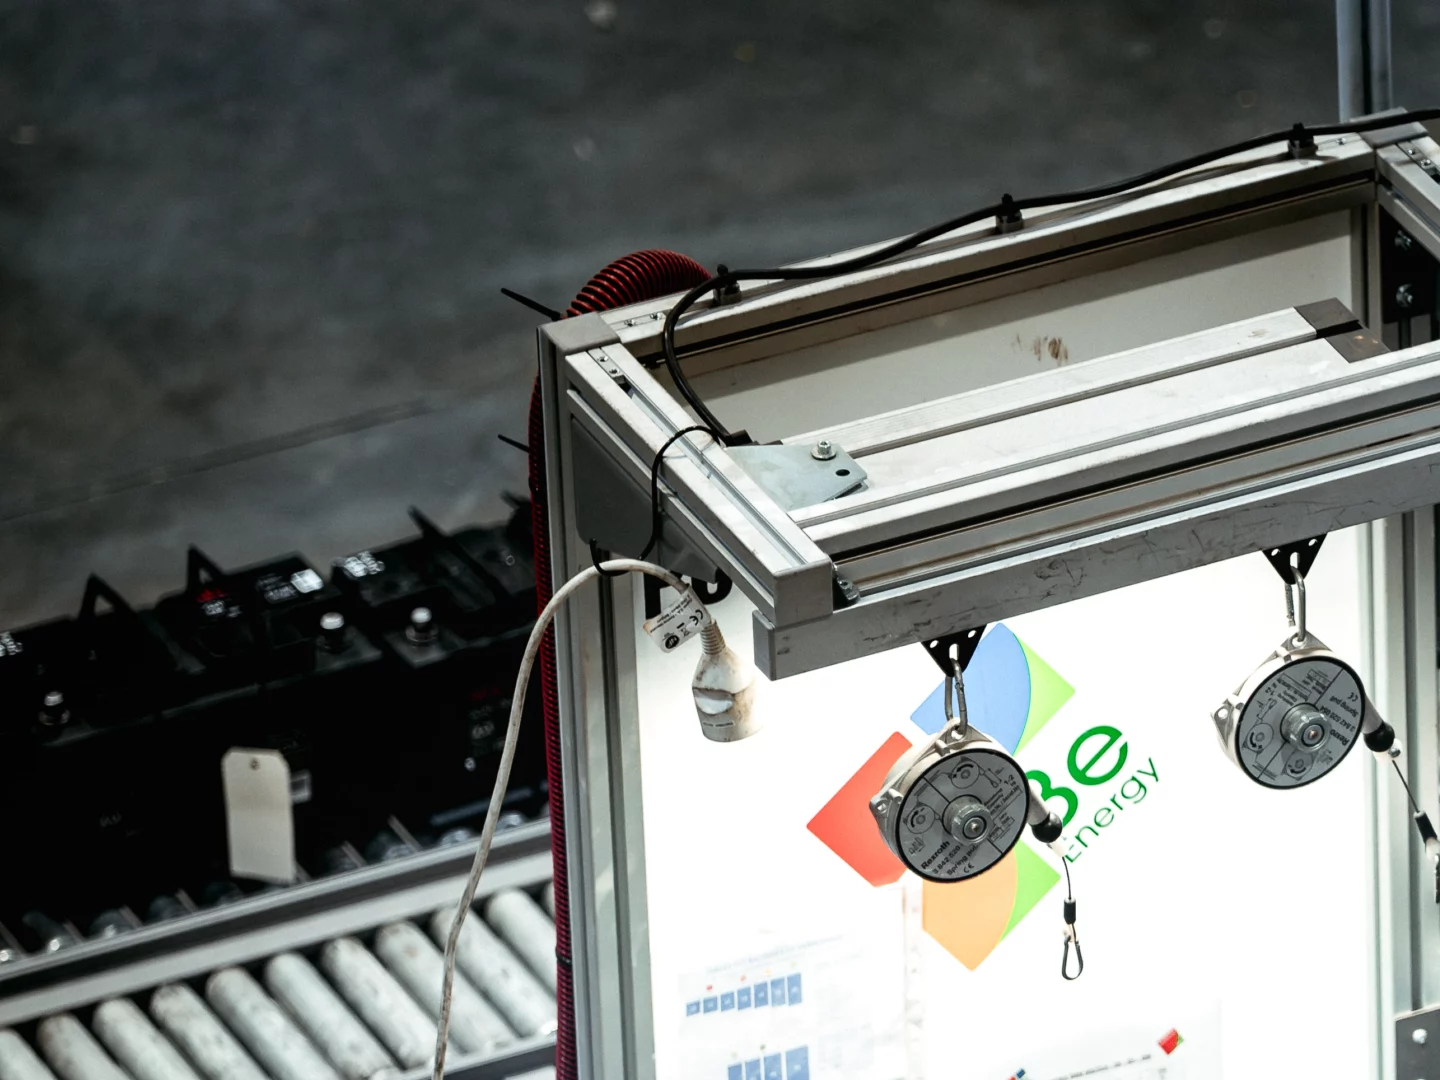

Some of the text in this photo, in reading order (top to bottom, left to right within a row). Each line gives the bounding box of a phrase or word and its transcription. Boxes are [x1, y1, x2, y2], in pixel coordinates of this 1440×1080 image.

[1329, 729, 1350, 746] Rexro
[921, 840, 950, 870] Rexroth
[947, 856, 969, 875] Spring
